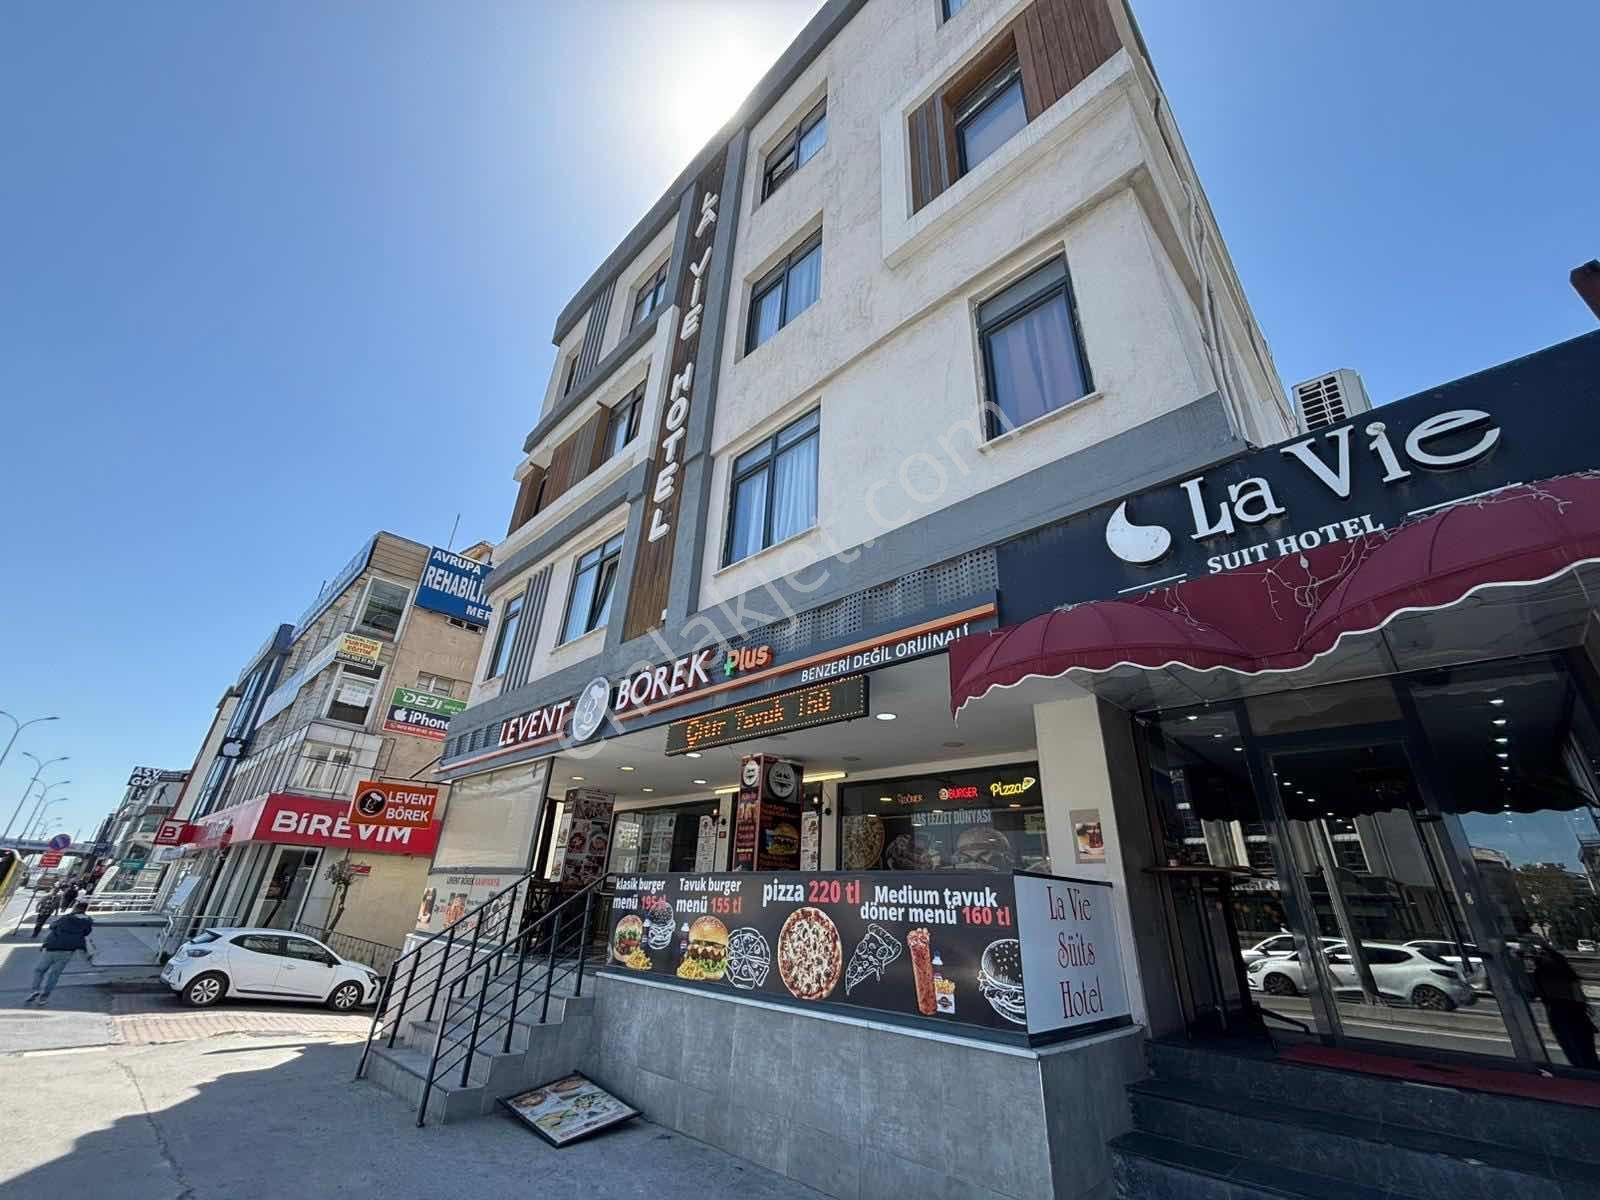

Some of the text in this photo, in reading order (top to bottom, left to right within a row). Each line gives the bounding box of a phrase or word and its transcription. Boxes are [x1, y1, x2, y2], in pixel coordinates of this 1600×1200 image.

[648, 361, 693, 542] HOTEL
[1181, 409, 1501, 540] La Vie
[1207, 514, 1385, 574] SUIT HOTEL
[432, 550, 480, 576] AVRUPA
[423, 565, 492, 607] REHABİLİ
[801, 658, 850, 682] BENZERİ
[853, 645, 892, 669] DEĞİL
[498, 700, 571, 746] LEVENT
[615, 650, 710, 711] BÖREK
[388, 790, 435, 806] LEVENT
[948, 786, 978, 800] BURGER
[386, 806, 430, 822] BÖREK
[616, 877, 666, 895] klasik burger
[679, 876, 742, 896] Tavuk burger
[762, 878, 860, 908] pizza 220 tl
[874, 885, 998, 908] Medium tavuk
[612, 894, 638, 911] menü
[676, 895, 743, 913] menü 155 tl
[860, 902, 1011, 926] döner menü 160 tl
[1046, 886, 1091, 921] La Vie
[1057, 931, 1096, 969] Süits
[1059, 976, 1104, 1019] Hotel
